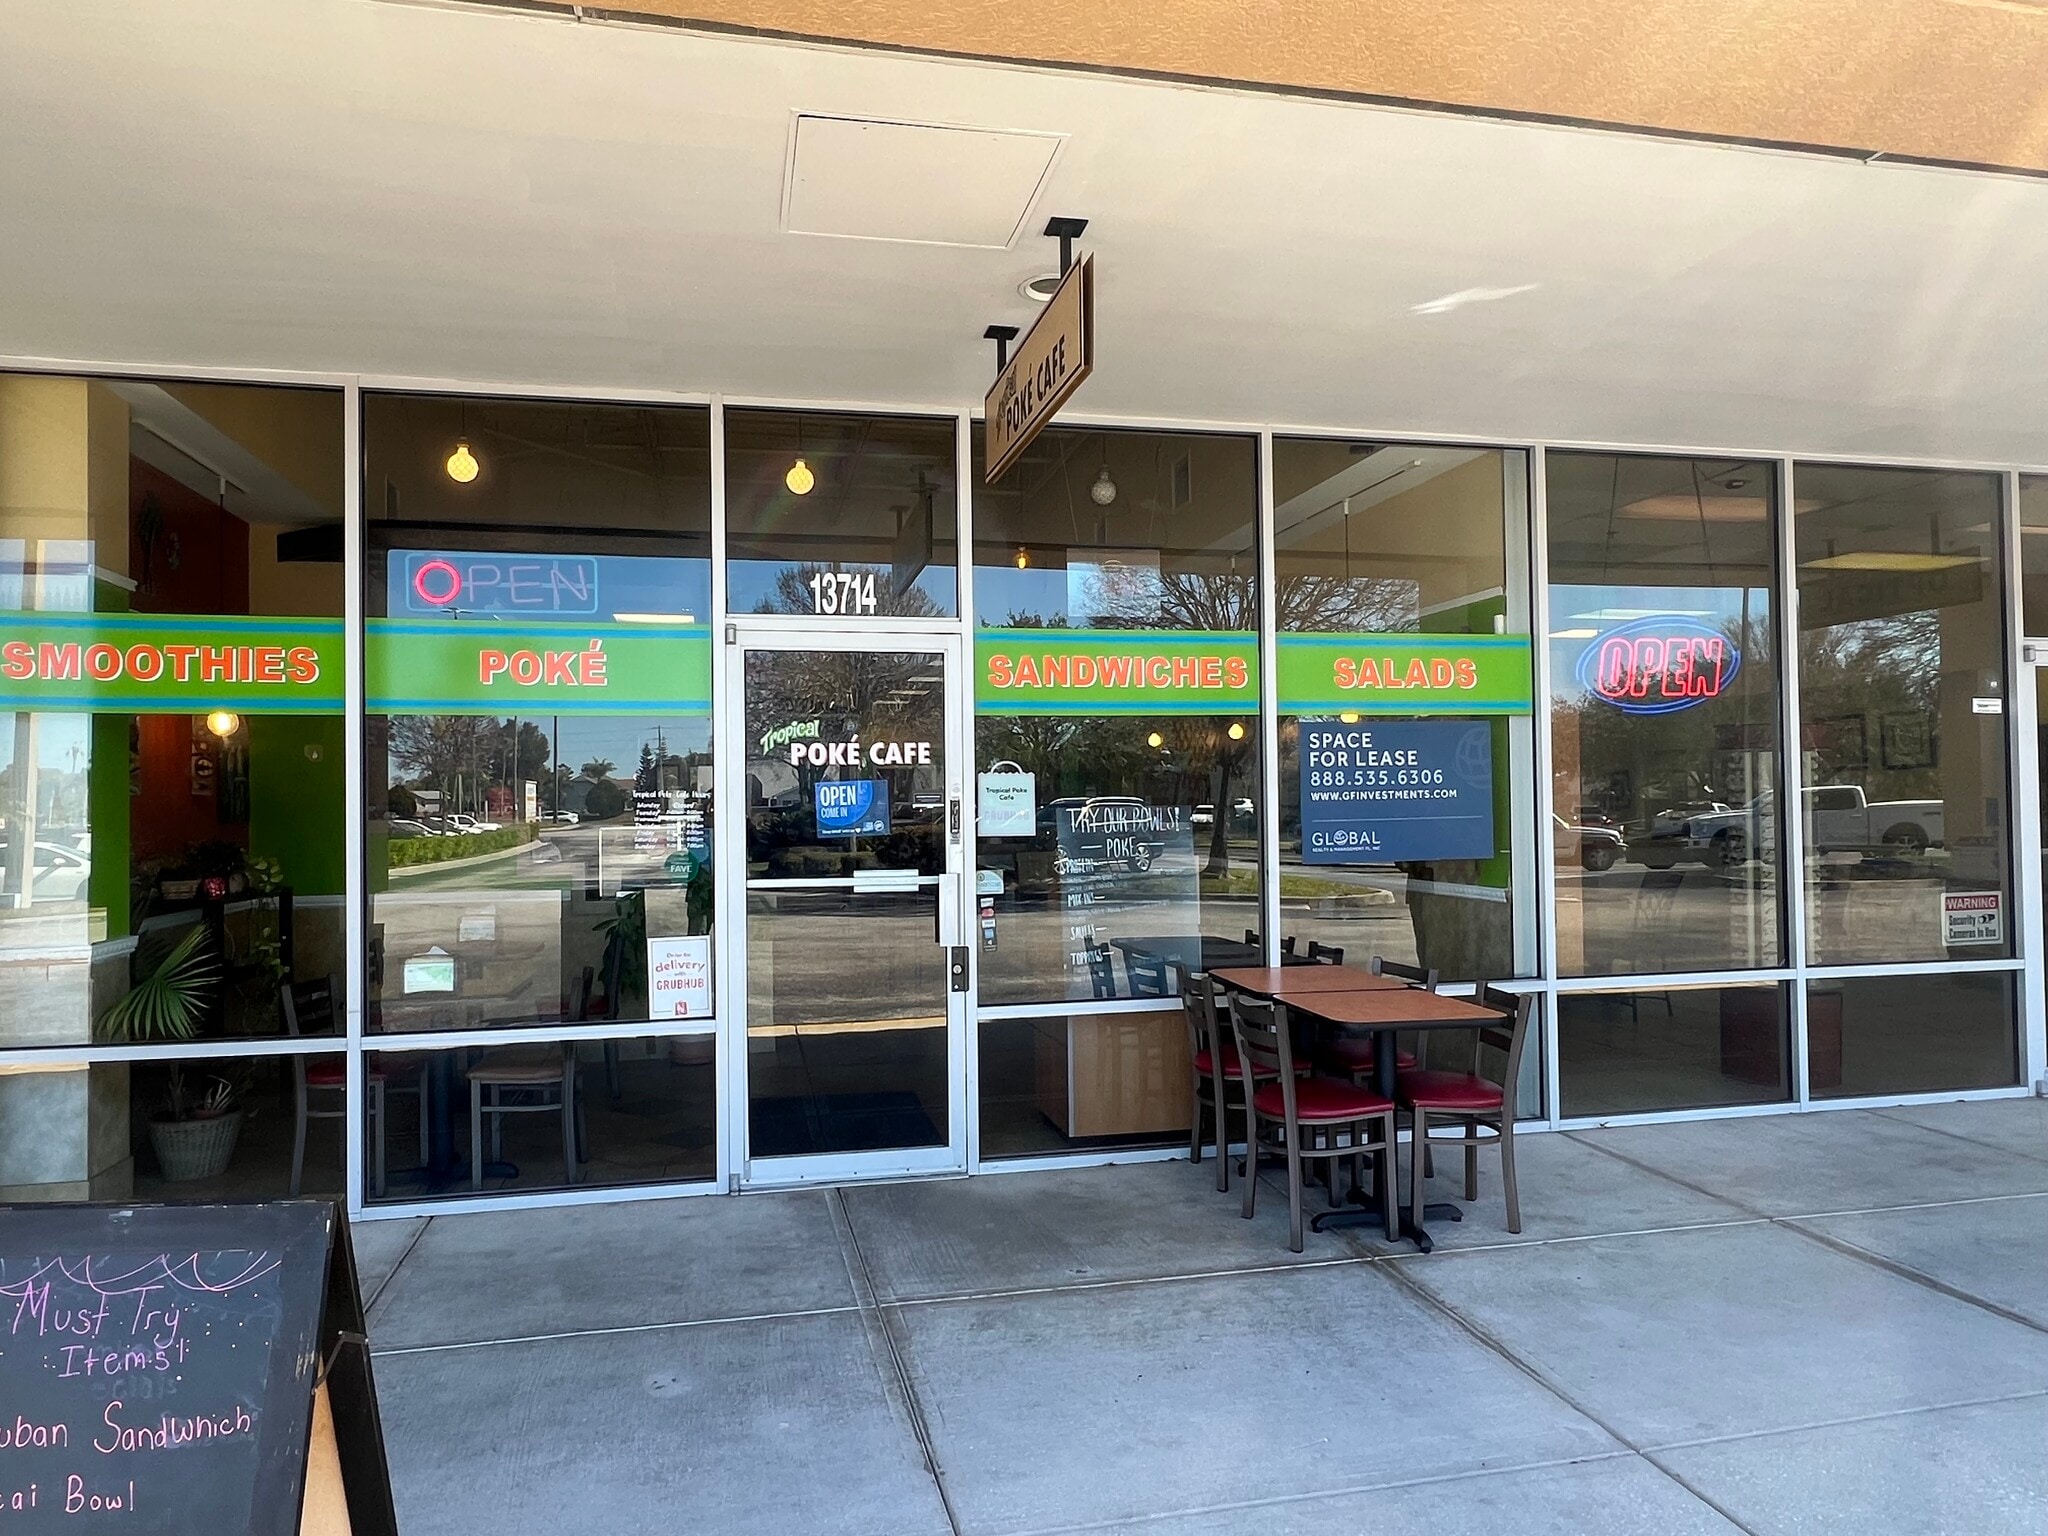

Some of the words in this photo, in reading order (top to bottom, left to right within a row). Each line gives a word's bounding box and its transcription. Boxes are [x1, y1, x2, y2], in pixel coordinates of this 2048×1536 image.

[1006, 363, 1034, 441] POKÉ
[1036, 334, 1066, 402] CAFE
[414, 559, 588, 605] OPEN
[810, 572, 877, 615] 13714
[1, 641, 320, 685] SMOOTHIES
[479, 639, 608, 687] POKÉ
[988, 653, 1250, 690] SANDWICHES
[1332, 656, 1479, 690] SALADS
[1597, 636, 1725, 698] OPEN
[760, 719, 821, 756] Tropical
[790, 734, 860, 766] POKÉ
[869, 741, 932, 766] CAFE
[1308, 732, 1373, 749] SPACE
[1309, 751, 1349, 768] FOR
[1355, 750, 1419, 767] LEASE
[1310, 769, 1443, 787] 888.535.6306
[820, 785, 857, 807] OPEN
[1310, 789, 1458, 801] WWW.GFINVESTMENTS.COM
[821, 807, 840, 818] COME
[840, 806, 848, 817] IN
[1066, 807, 1099, 833] TRY
[1103, 807, 1127, 834] OUR
[1132, 806, 1180, 832] BOWLS!
[1106, 836, 1137, 858] POKE
[1311, 829, 1381, 846] GLOBAL
[670, 864, 693, 873] FAVE
[1946, 897, 1996, 909] WARNING
[1949, 914, 1977, 927] Security
[1949, 928, 1976, 939] Cameras
[655, 959, 705, 973] delivery
[656, 978, 705, 991] GRUBHUB
[12, 1281, 109, 1336] Must
[131, 1286, 181, 1348] Try
[58, 1338, 185, 1380] Items!
[65, 1474, 135, 1513] Bowl
